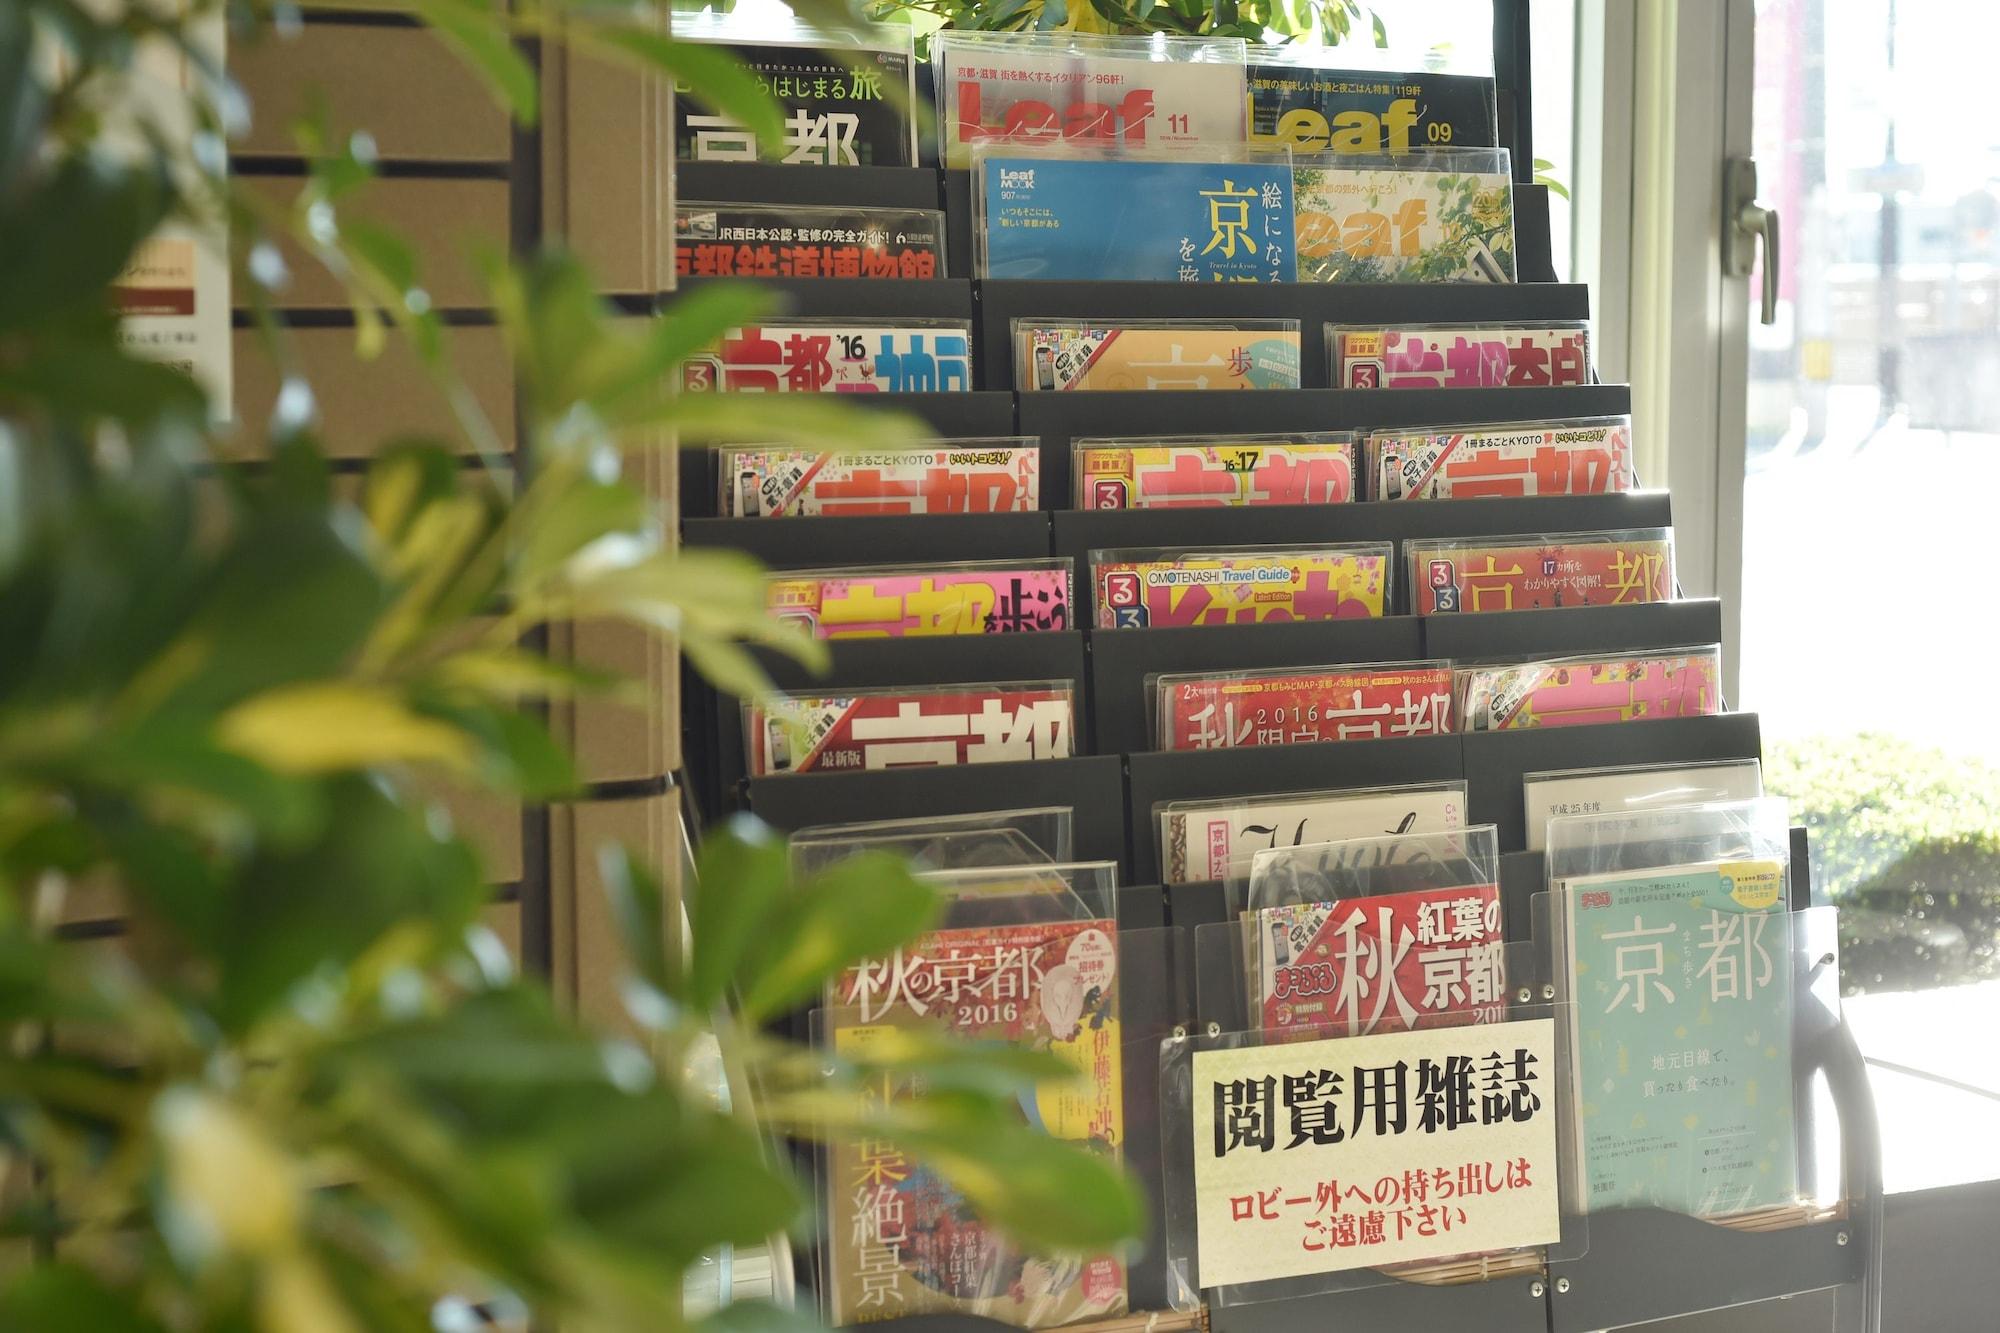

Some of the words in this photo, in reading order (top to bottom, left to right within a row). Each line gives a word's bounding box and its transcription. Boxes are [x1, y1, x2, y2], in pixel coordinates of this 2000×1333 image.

[958, 81, 1155, 145] Leaf
[1167, 114, 1188, 134] 11
[1427, 122, 1453, 143] 09
[1001, 168, 1035, 180] Leaf
[1001, 191, 1015, 200] 907
[718, 227, 889, 245] JR西日本公認・監修の完全ガイド!
[1199, 179, 1258, 282] 京
[1149, 571, 1219, 585] OMOTENASHI
[1222, 570, 1255, 582] Travel
[1258, 568, 1291, 581] Guide
[1256, 705, 1318, 725] 2016
[1334, 906, 1420, 1036] 秋
[1418, 939, 1506, 1010] 京都
[846, 945, 1047, 1023] 秋の京都
[958, 1003, 1018, 1026] 2016
[1473, 1004, 1506, 1026] 201
[1213, 1048, 1541, 1158] 閲覧用雑誌
[1229, 1157, 1533, 1222] ロビー外への持ち出しは
[1302, 1204, 1468, 1251] ご遠慮下さい
